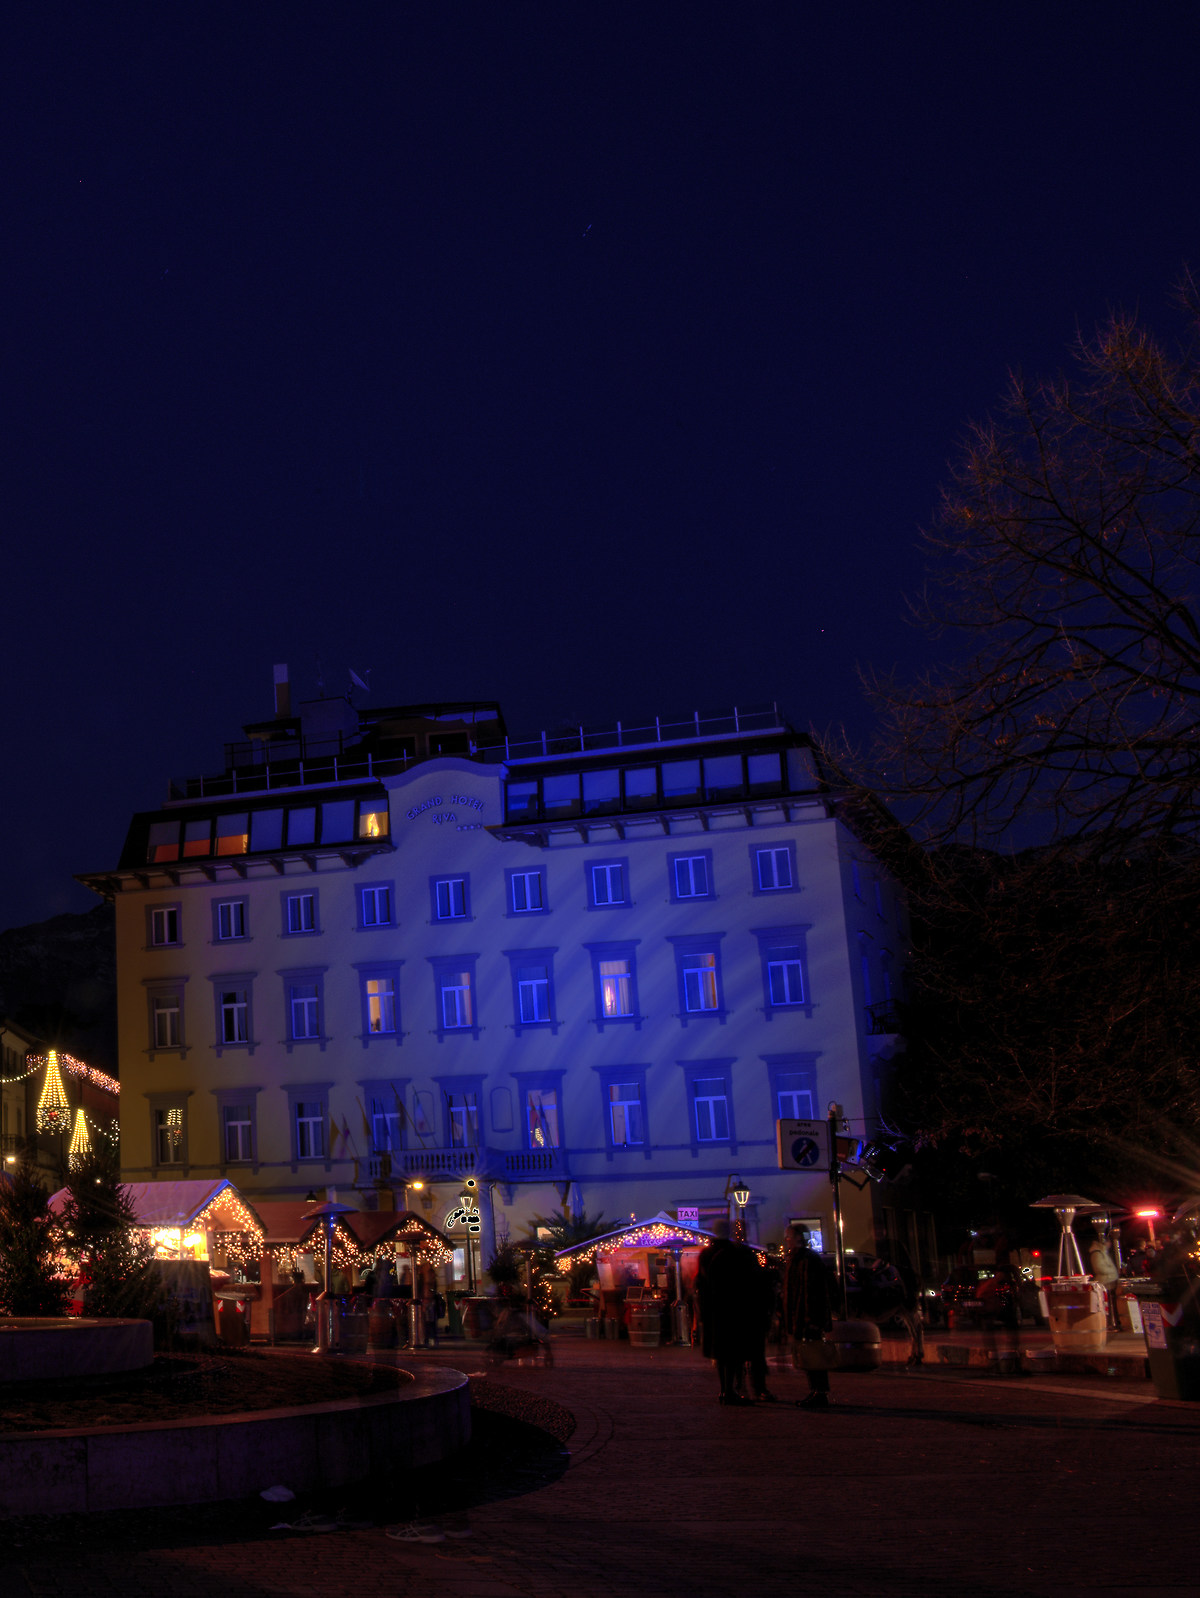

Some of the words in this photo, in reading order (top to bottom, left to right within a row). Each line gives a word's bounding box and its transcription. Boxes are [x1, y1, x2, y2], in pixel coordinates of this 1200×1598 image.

[407, 797, 442, 820] GRAND
[451, 795, 484, 811] HOTEL
[432, 813, 457, 824] RIVA
